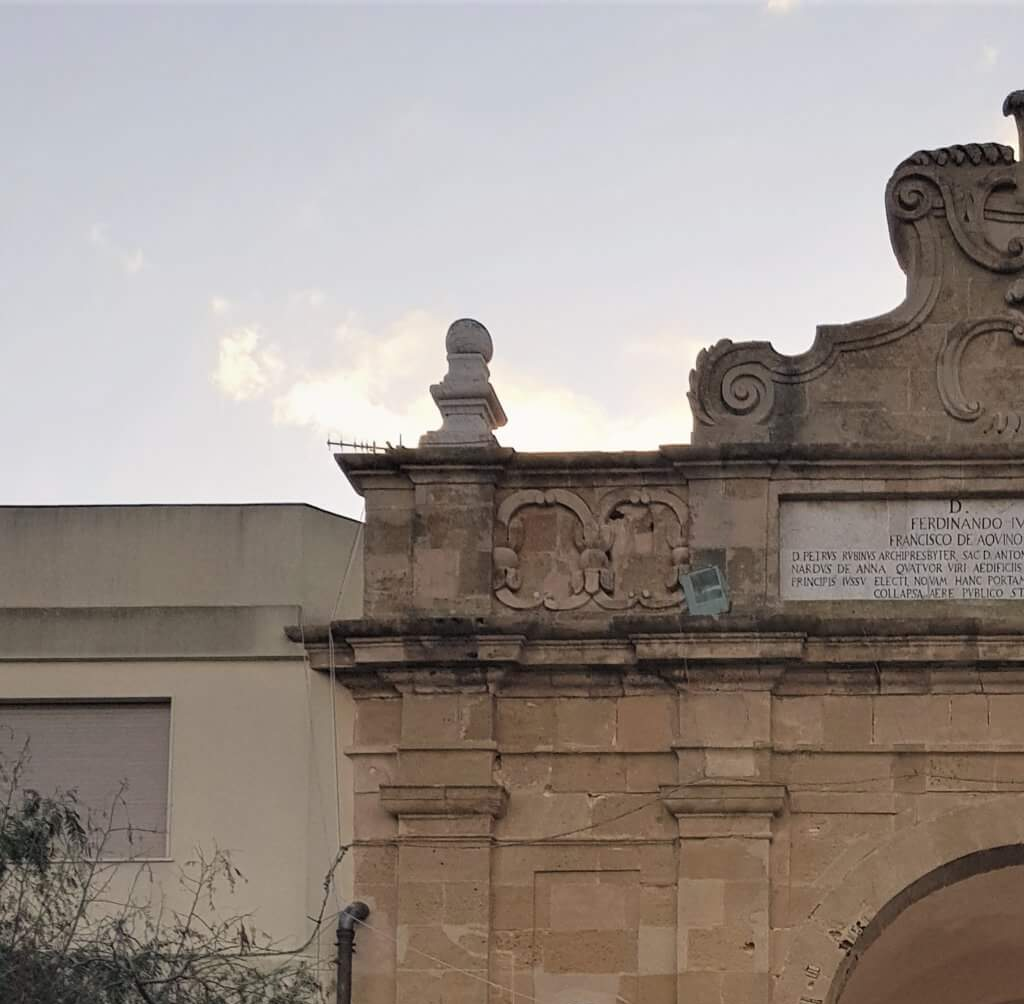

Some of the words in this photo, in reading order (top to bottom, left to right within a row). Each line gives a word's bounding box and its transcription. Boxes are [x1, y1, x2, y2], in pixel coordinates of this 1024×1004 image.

[911, 516, 1002, 530] FERDINANDO
[889, 533, 952, 546] FRANCISCO
[856, 564, 886, 574] ANNA
[955, 576, 982, 586] HANC
